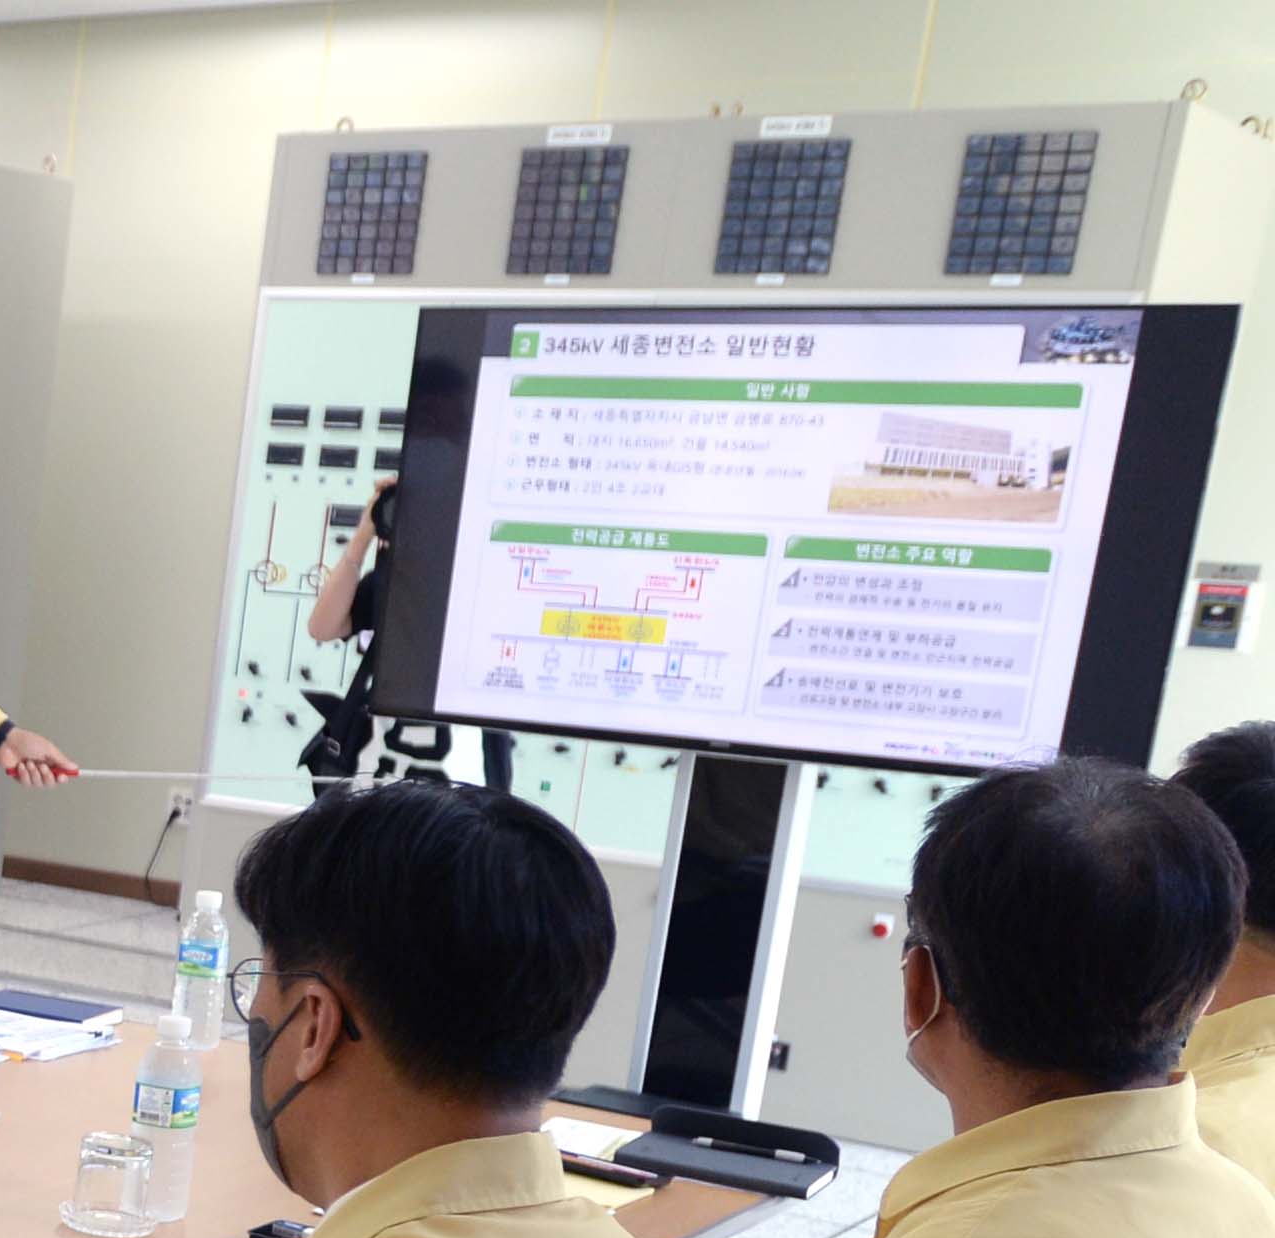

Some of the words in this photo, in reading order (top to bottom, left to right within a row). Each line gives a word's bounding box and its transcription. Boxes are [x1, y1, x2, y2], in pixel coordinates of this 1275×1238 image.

[544, 337, 604, 355] 345kV
[610, 334, 716, 357] 세종변전소
[726, 334, 816, 357] 일반현황
[746, 382, 774, 399] 일반
[780, 383, 810, 400] 사항
[855, 543, 899, 561] 변전소
[906, 546, 936, 561] 주요
